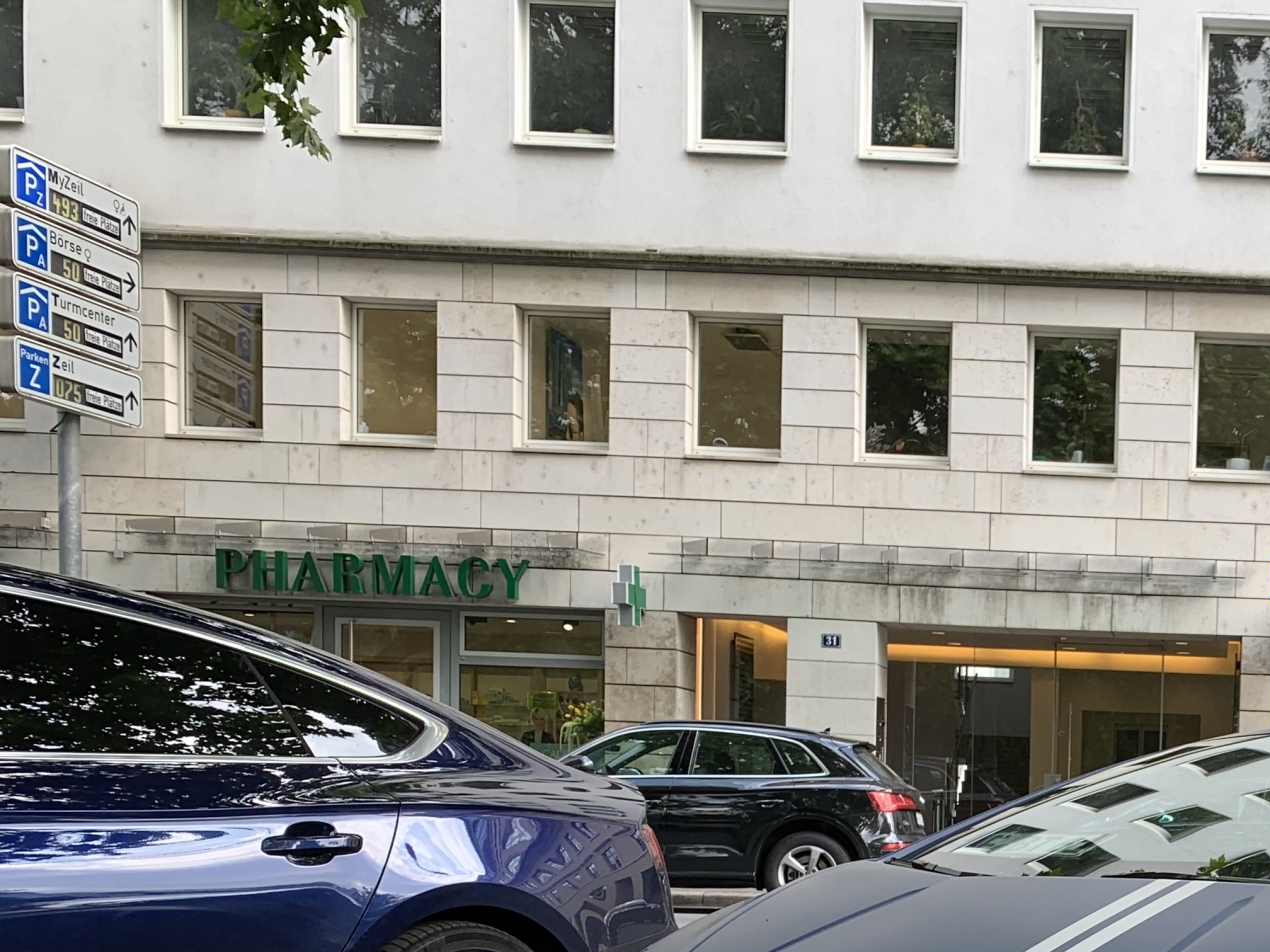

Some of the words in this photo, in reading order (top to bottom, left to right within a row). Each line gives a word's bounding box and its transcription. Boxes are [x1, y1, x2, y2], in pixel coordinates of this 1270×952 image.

[48, 168, 84, 196] MyZeil
[52, 193, 79, 221] 493
[83, 209, 98, 226] freie
[100, 216, 119, 234] Plätze
[49, 231, 82, 255] Börse
[63, 258, 80, 282] 50
[84, 269, 99, 285] freie
[101, 274, 120, 293] Plätze
[51, 293, 116, 327] Turmcenter
[63, 319, 81, 342] 50
[85, 330, 100, 344] freie
[102, 334, 121, 351] Plätze
[20, 348, 49, 366] Parken
[52, 355, 75, 374] Zeil
[29, 363, 41, 389] Z
[86, 391, 102, 405] freie
[103, 395, 122, 410] Plätze
[215, 548, 530, 599] PHARMACY
[825, 635, 837, 646] 31
